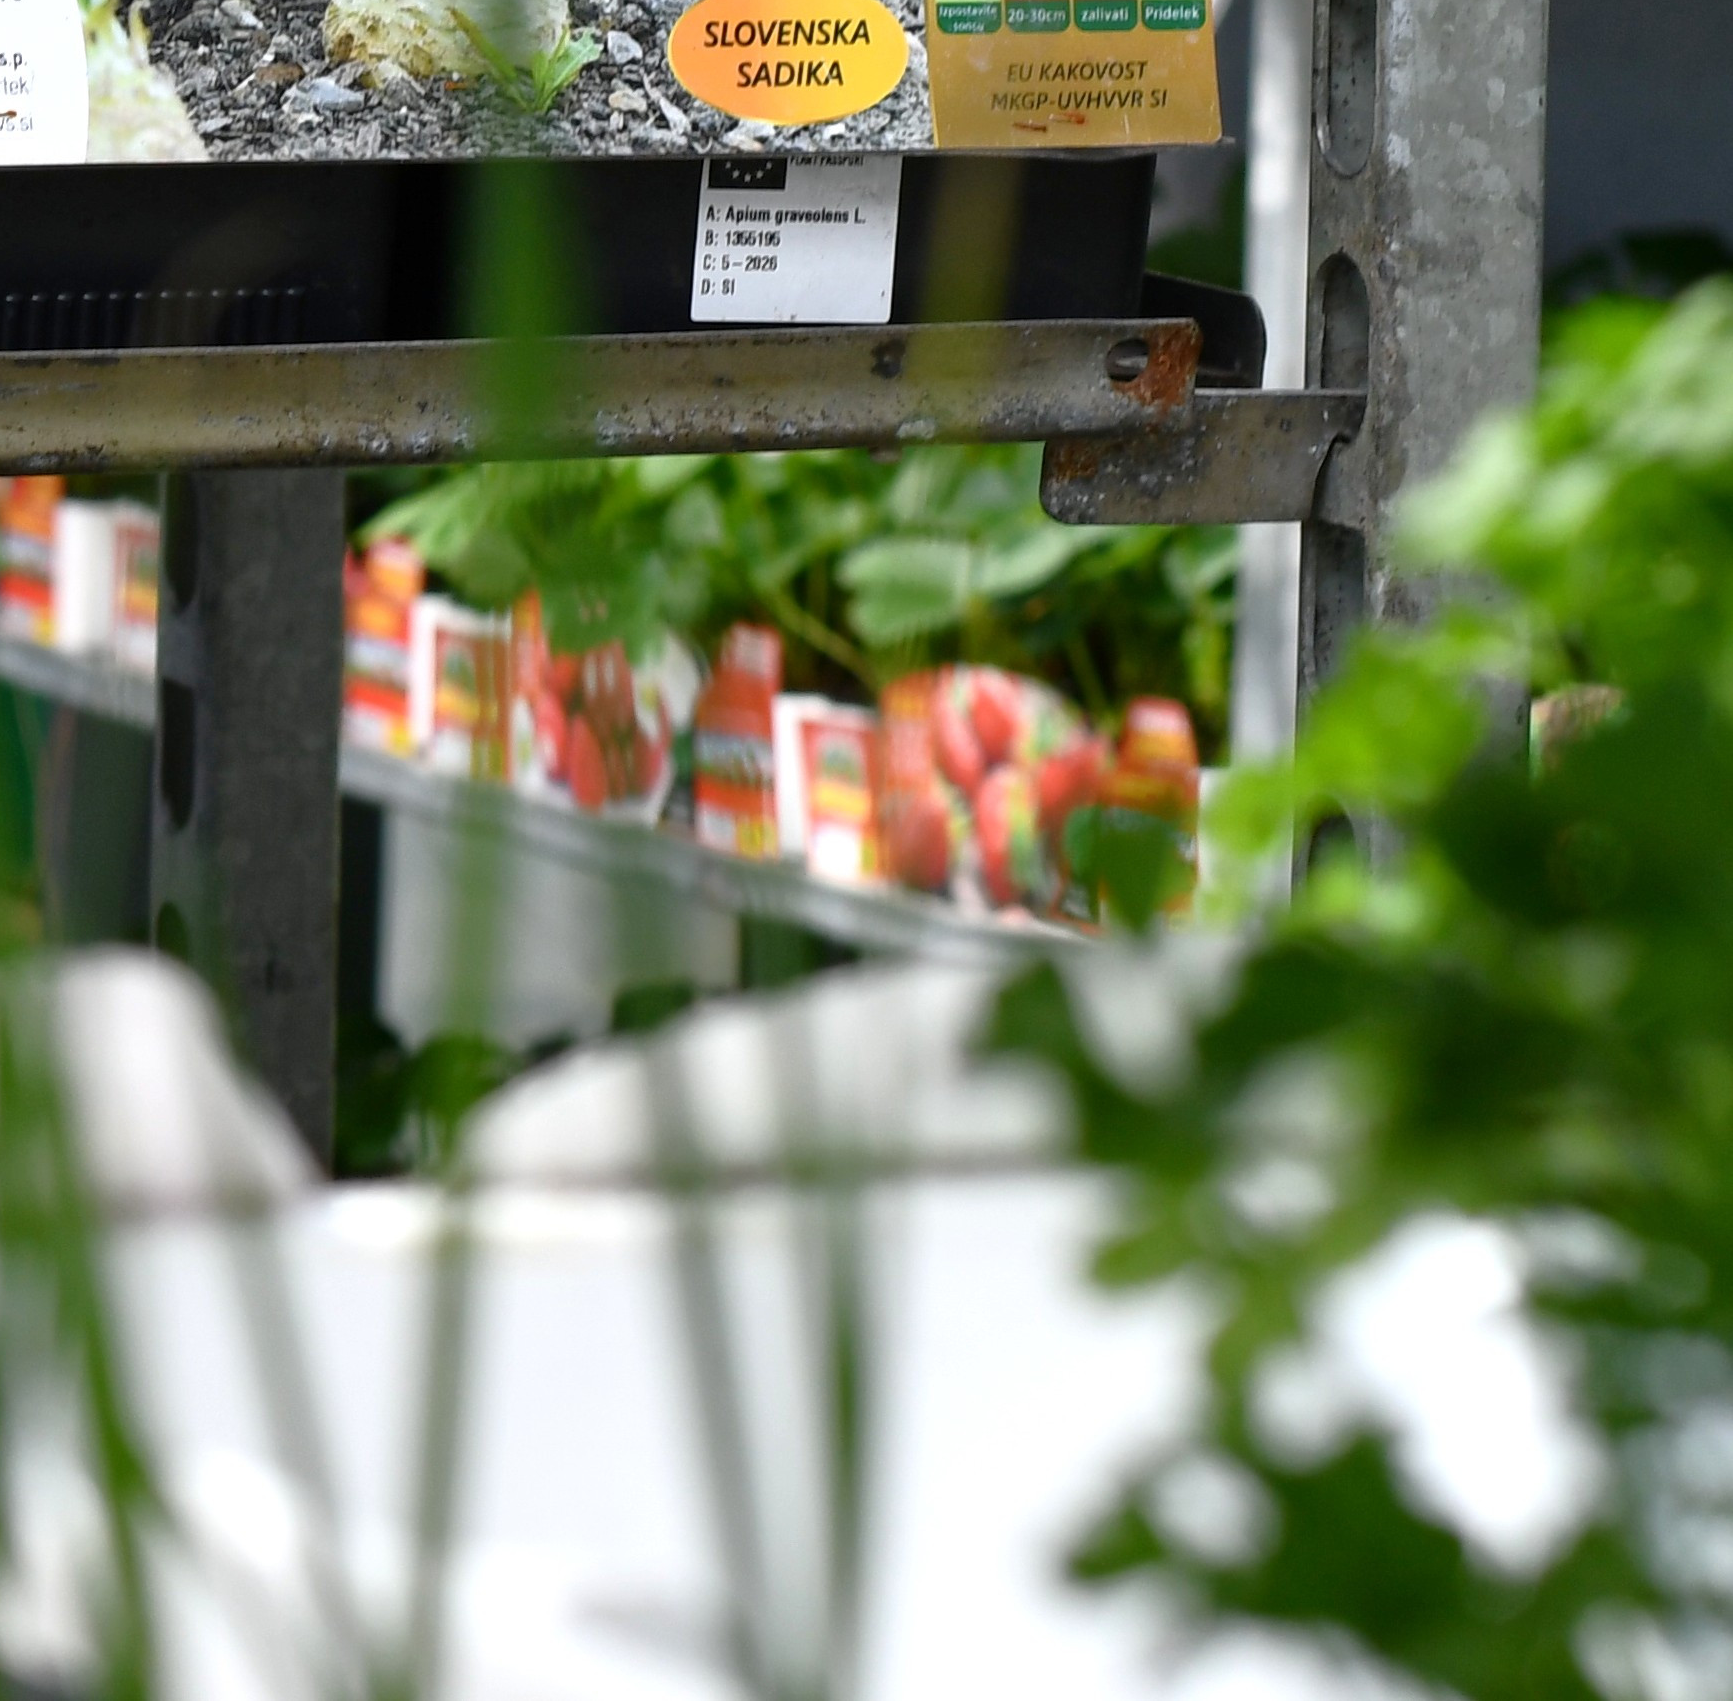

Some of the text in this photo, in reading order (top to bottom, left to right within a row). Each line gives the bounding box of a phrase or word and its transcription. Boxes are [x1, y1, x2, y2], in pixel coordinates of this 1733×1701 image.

[1081, 7, 1129, 22] zalivati
[1145, 5, 1200, 21] Pridelek
[703, 19, 872, 49] SLOVENSKA
[736, 61, 844, 88] SADIKA
[1007, 60, 1149, 82] EU KAKOVOST
[1149, 89, 1168, 108] SI
[706, 205, 866, 226] A: Apium graveolens L.
[703, 254, 716, 271] C:
[701, 278, 715, 296] D:
